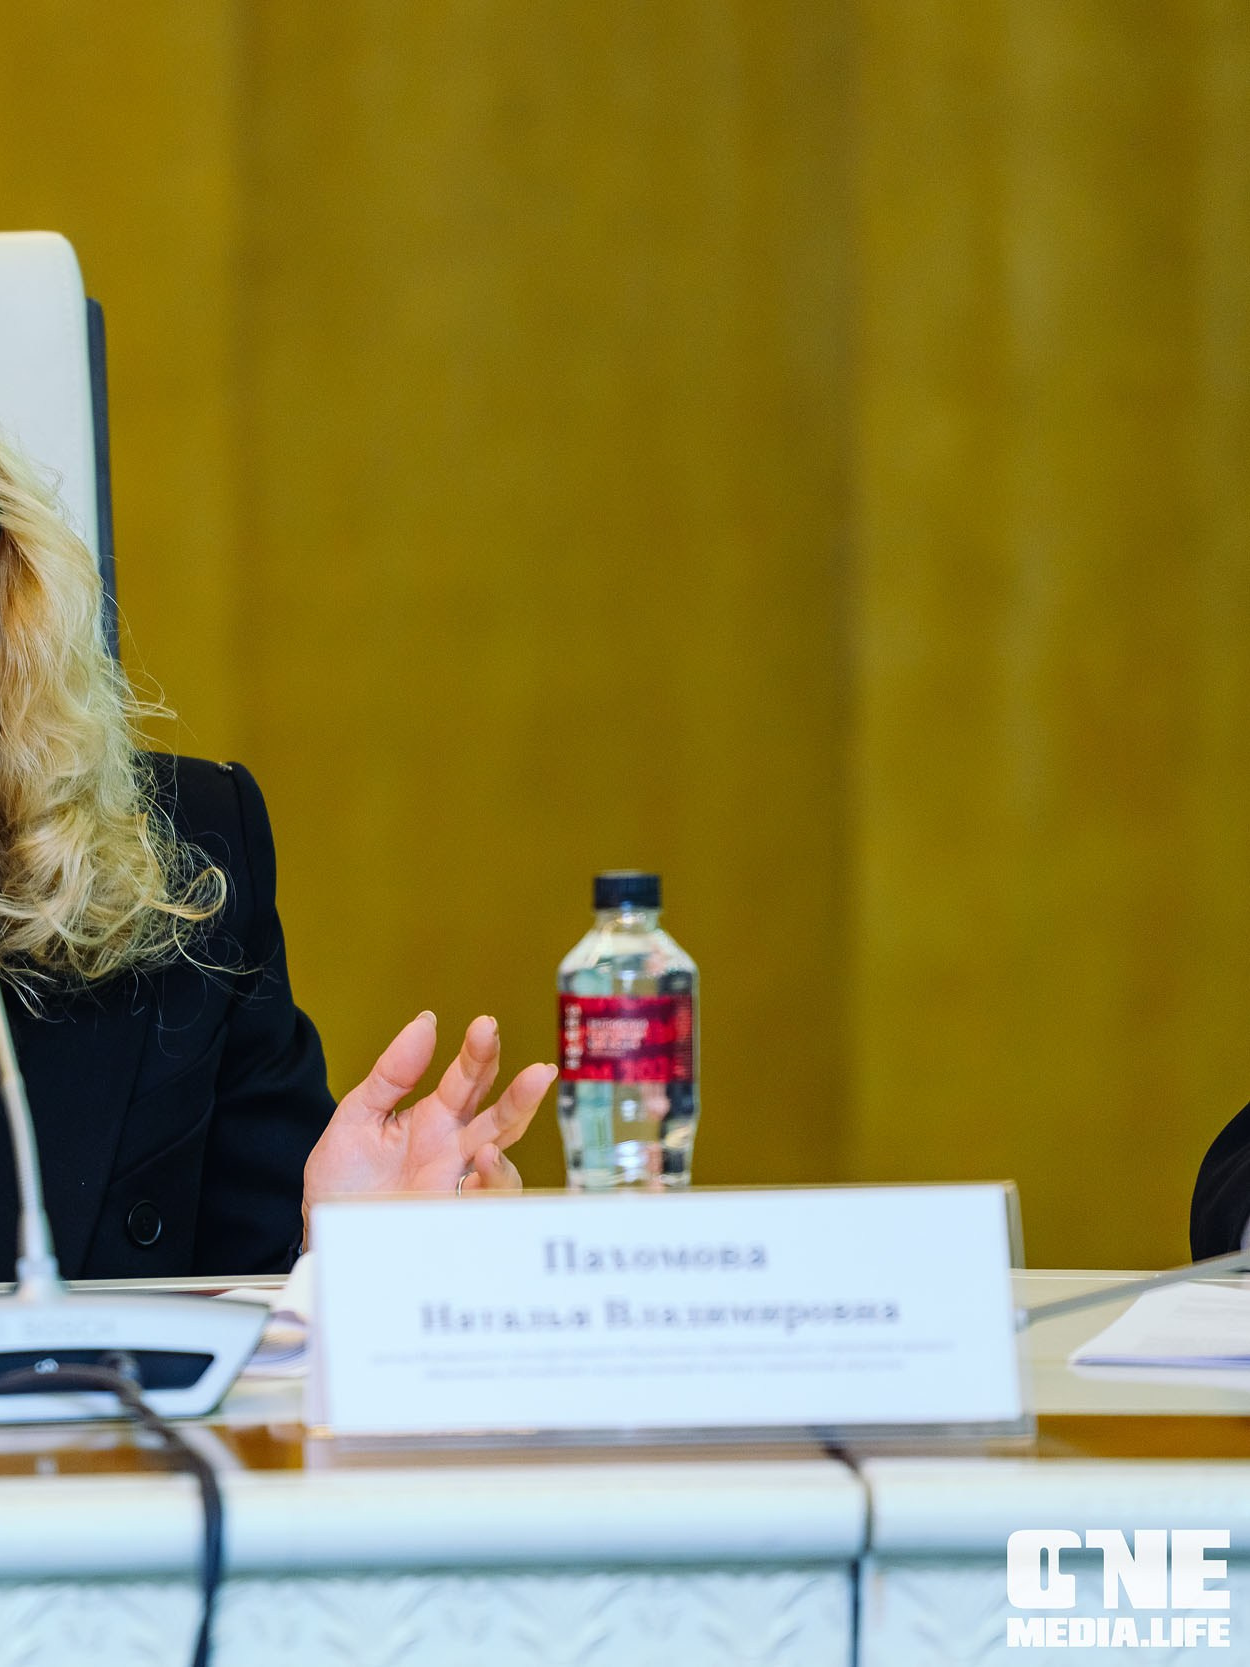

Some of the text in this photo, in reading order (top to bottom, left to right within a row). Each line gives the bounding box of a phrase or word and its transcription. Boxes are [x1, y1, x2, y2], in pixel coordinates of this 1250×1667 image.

[542, 1236, 768, 1276] Пахомова
[420, 1296, 900, 1337] Наталья Владимировна
